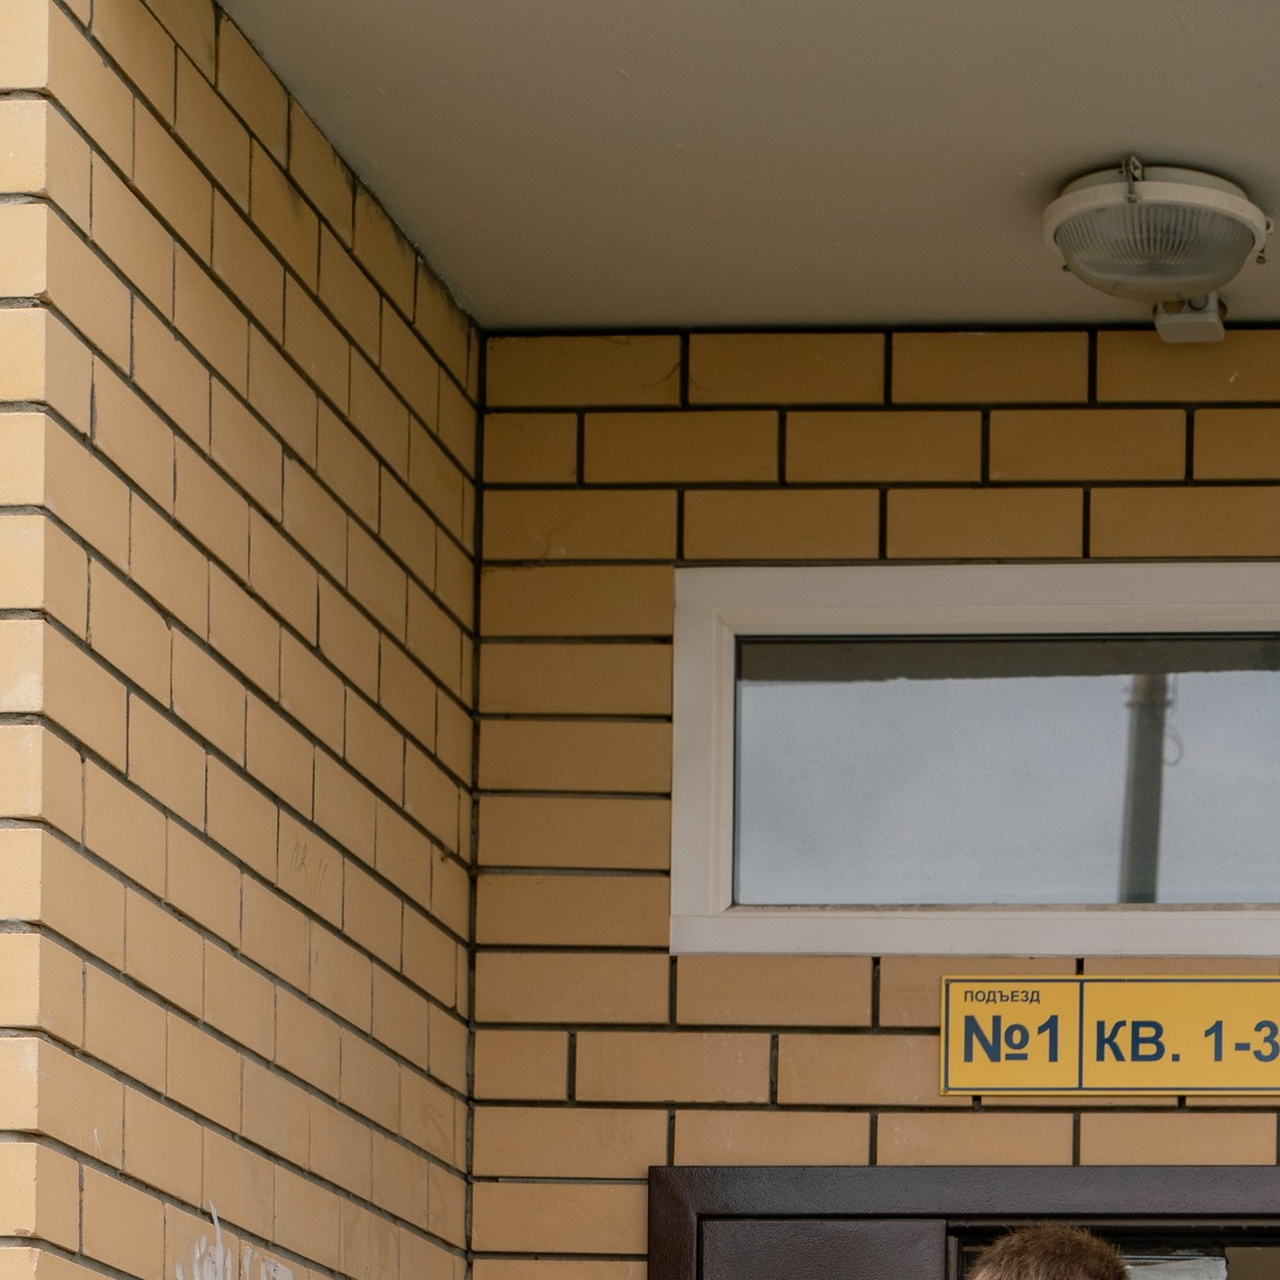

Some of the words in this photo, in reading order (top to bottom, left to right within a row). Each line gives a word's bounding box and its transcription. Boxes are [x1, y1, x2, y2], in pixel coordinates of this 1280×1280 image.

[964, 990, 1041, 1004] ПОДЪЕЗД
[964, 1014, 1059, 1063] №1
[1096, 1020, 1181, 1062] КВ.
